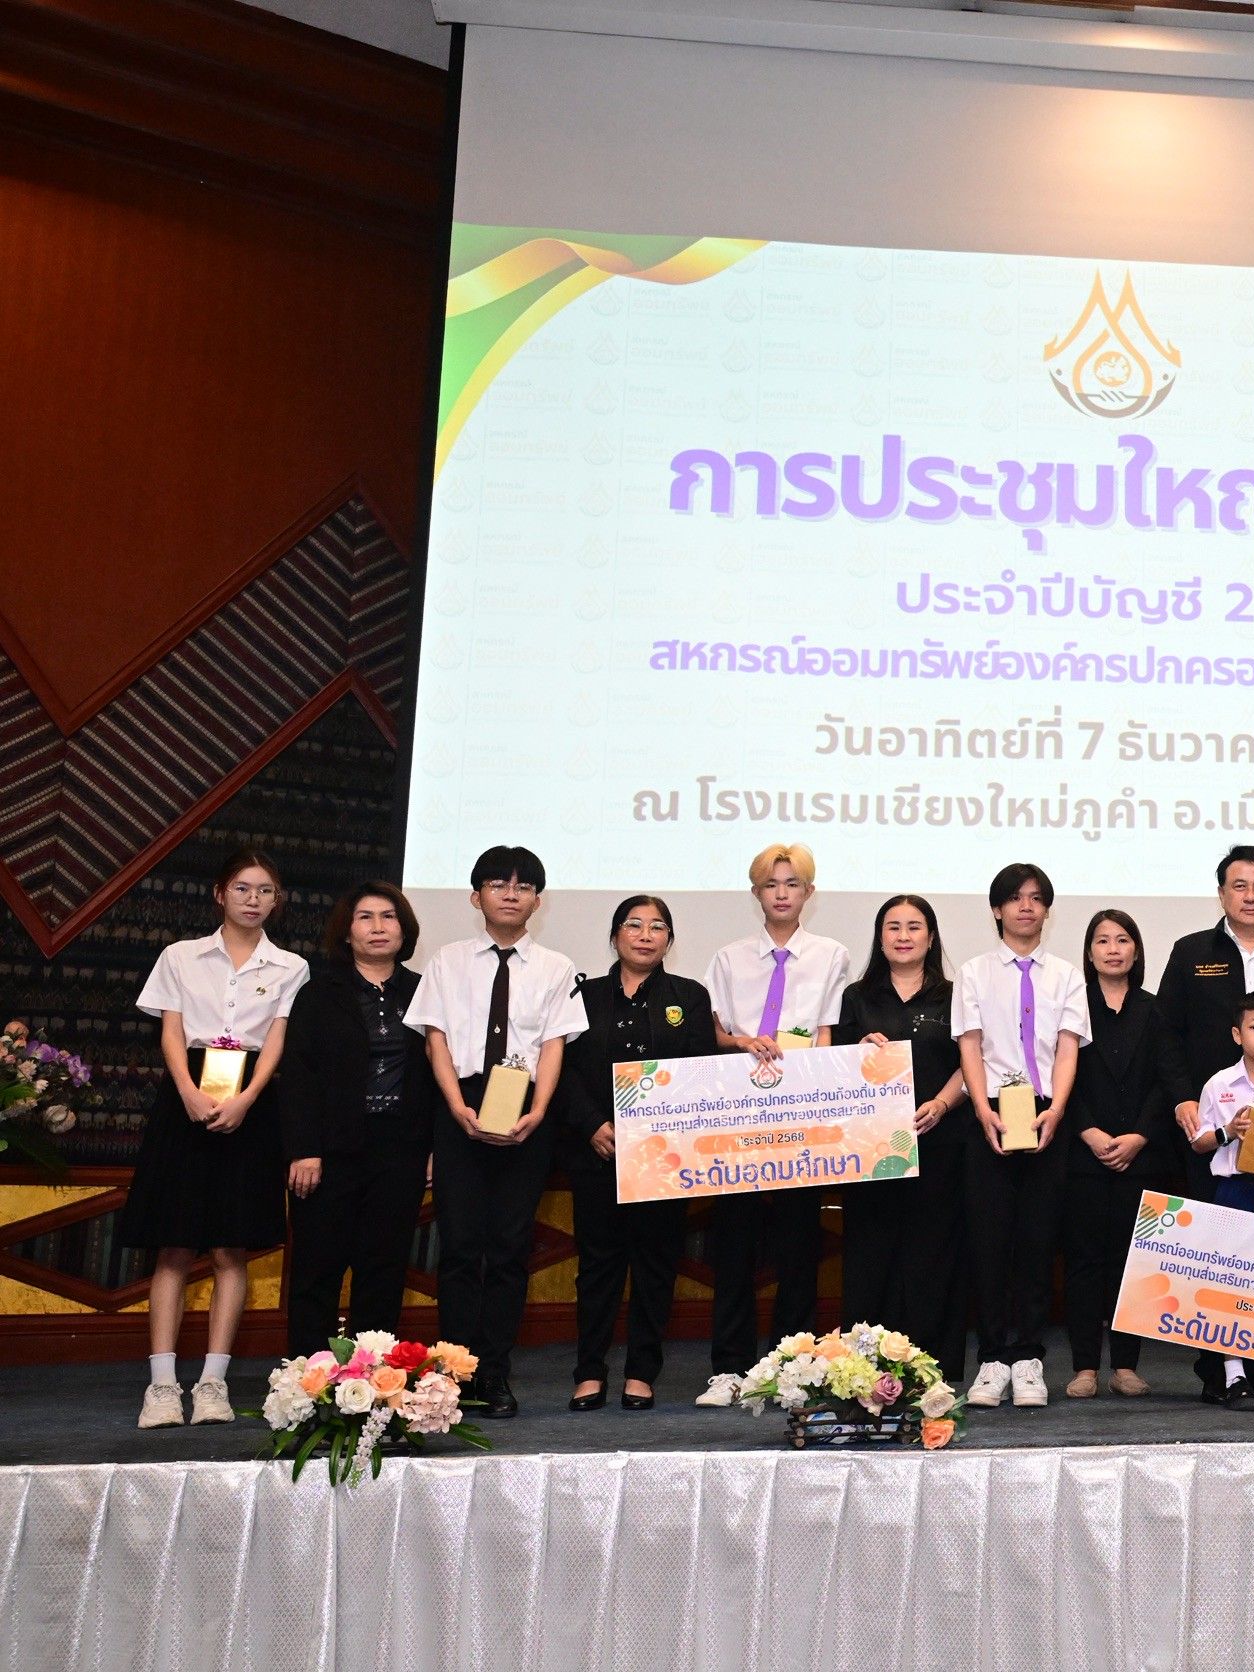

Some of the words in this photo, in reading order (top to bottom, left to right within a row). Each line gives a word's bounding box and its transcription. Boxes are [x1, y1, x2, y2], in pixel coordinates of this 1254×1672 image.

[896, 569, 1202, 624] ประจำปีบัญชี
[814, 705, 1063, 760] วันอาทิตย์ที่
[1078, 721, 1105, 760] 7
[632, 789, 680, 822] ณ
[695, 775, 1158, 842] โรงแรมเชียงใหม่ภูคำ
[777, 1131, 805, 1144] 2568
[678, 1148, 861, 1191] ระดับอุดมศึกษา
